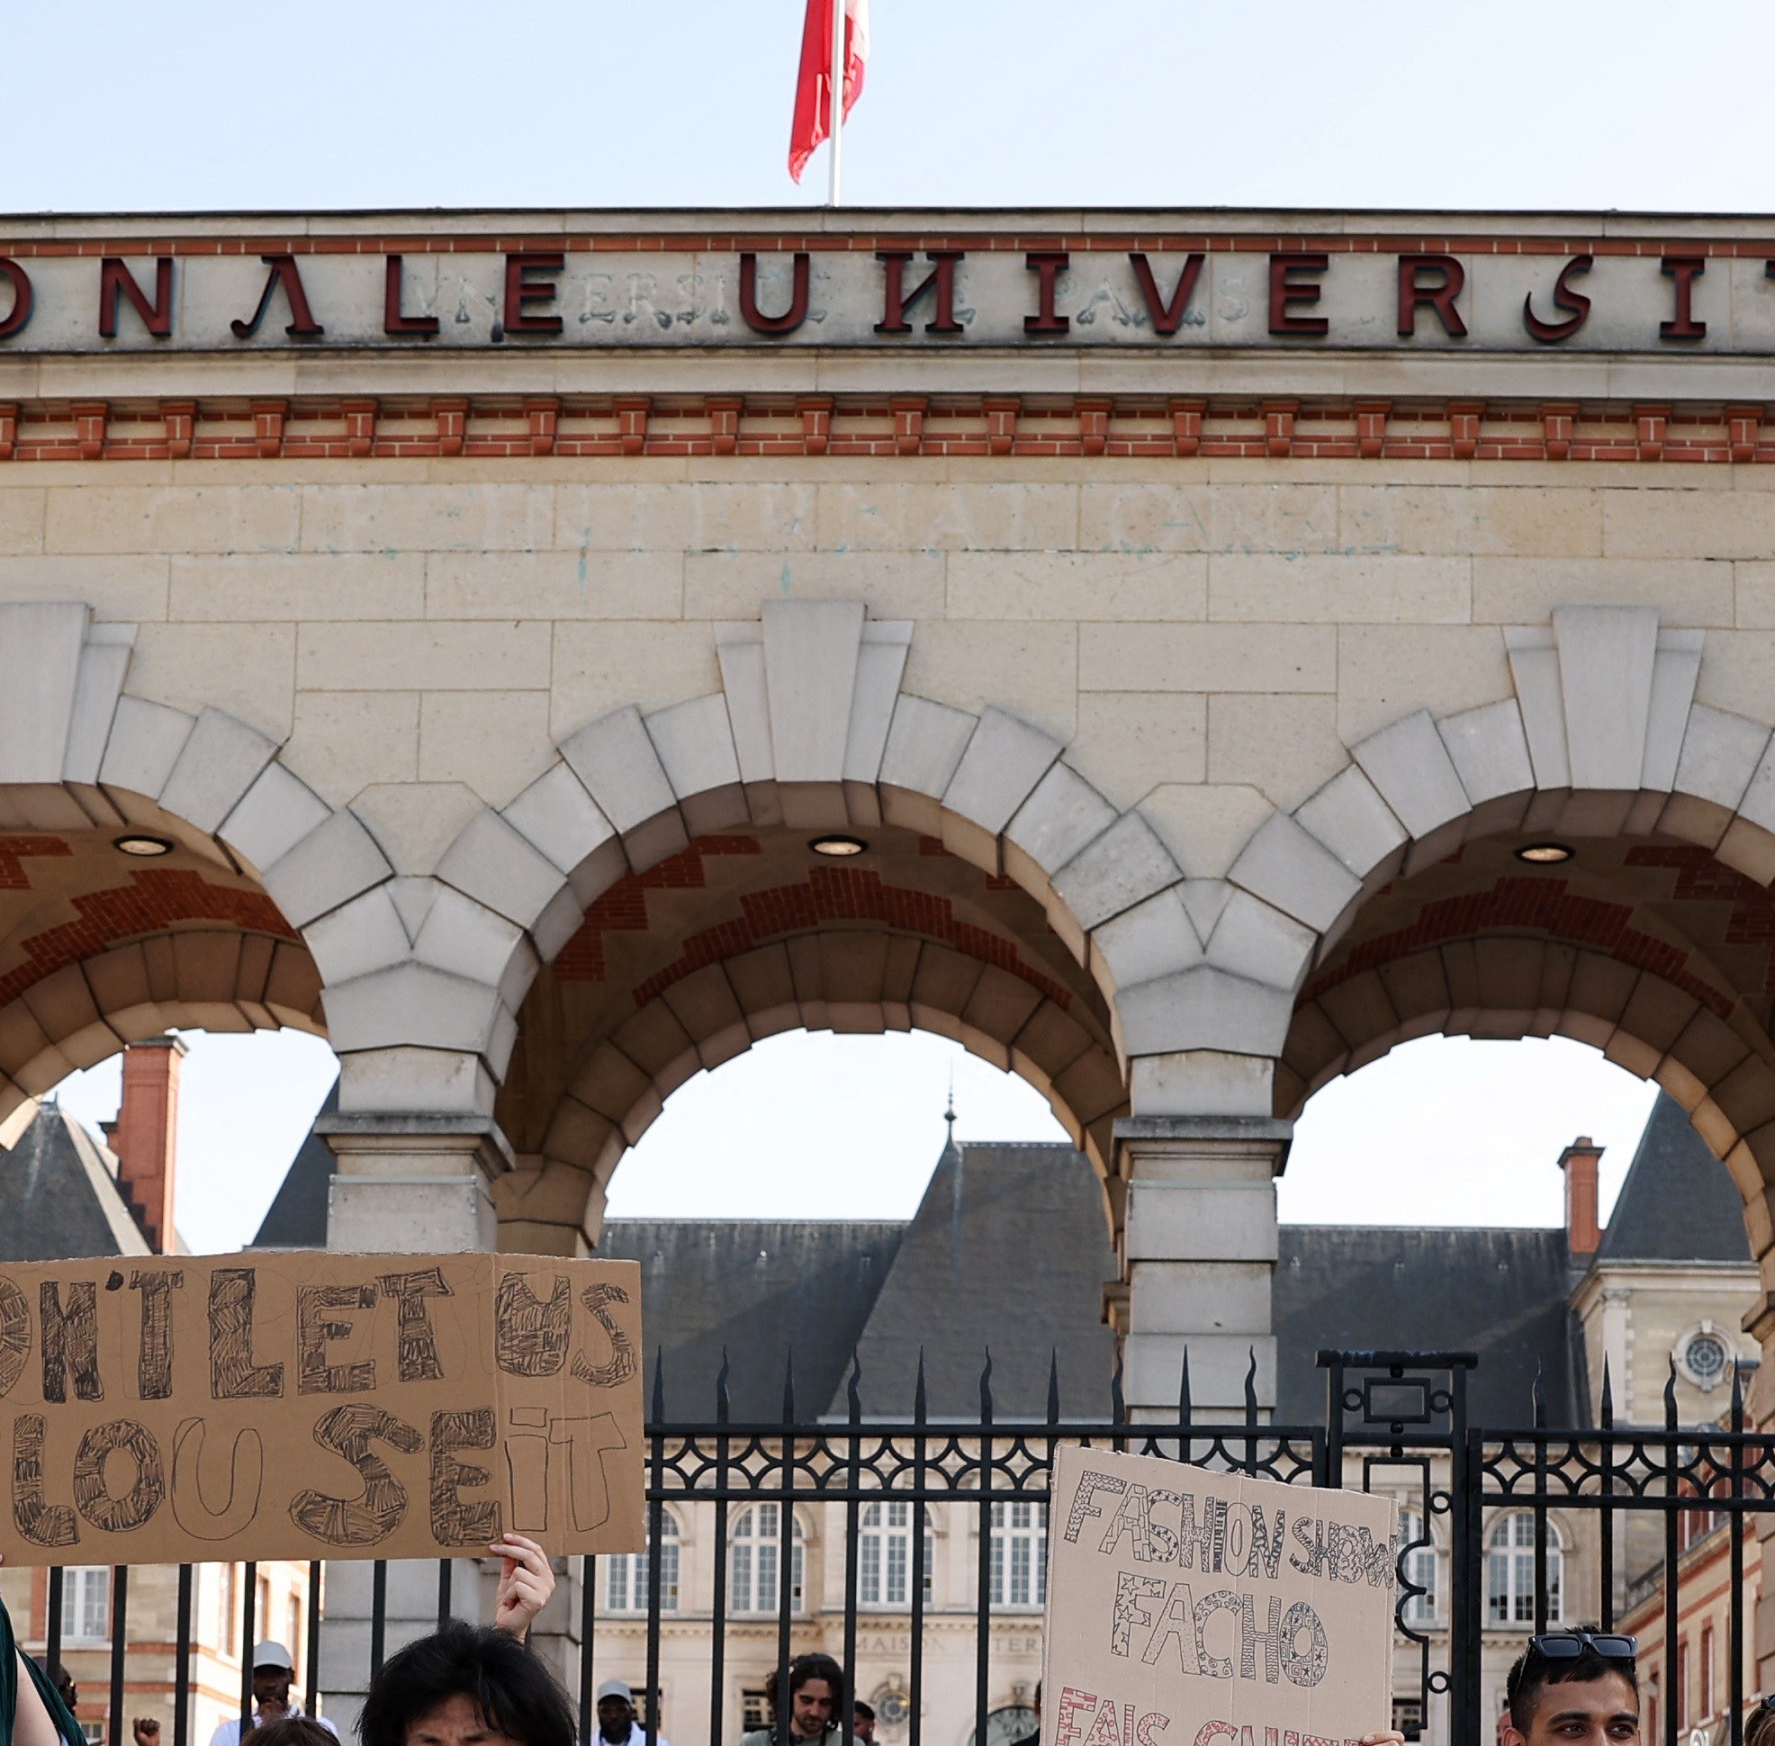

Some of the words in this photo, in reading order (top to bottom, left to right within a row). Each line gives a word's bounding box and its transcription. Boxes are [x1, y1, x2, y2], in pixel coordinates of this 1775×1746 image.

[208, 1266, 455, 1400] LET
[493, 1271, 639, 1389] US
[1062, 1469, 1287, 1580] FASHION
[1288, 1515, 1399, 1590] SHOW
[1110, 1571, 1329, 1688] FACHO
